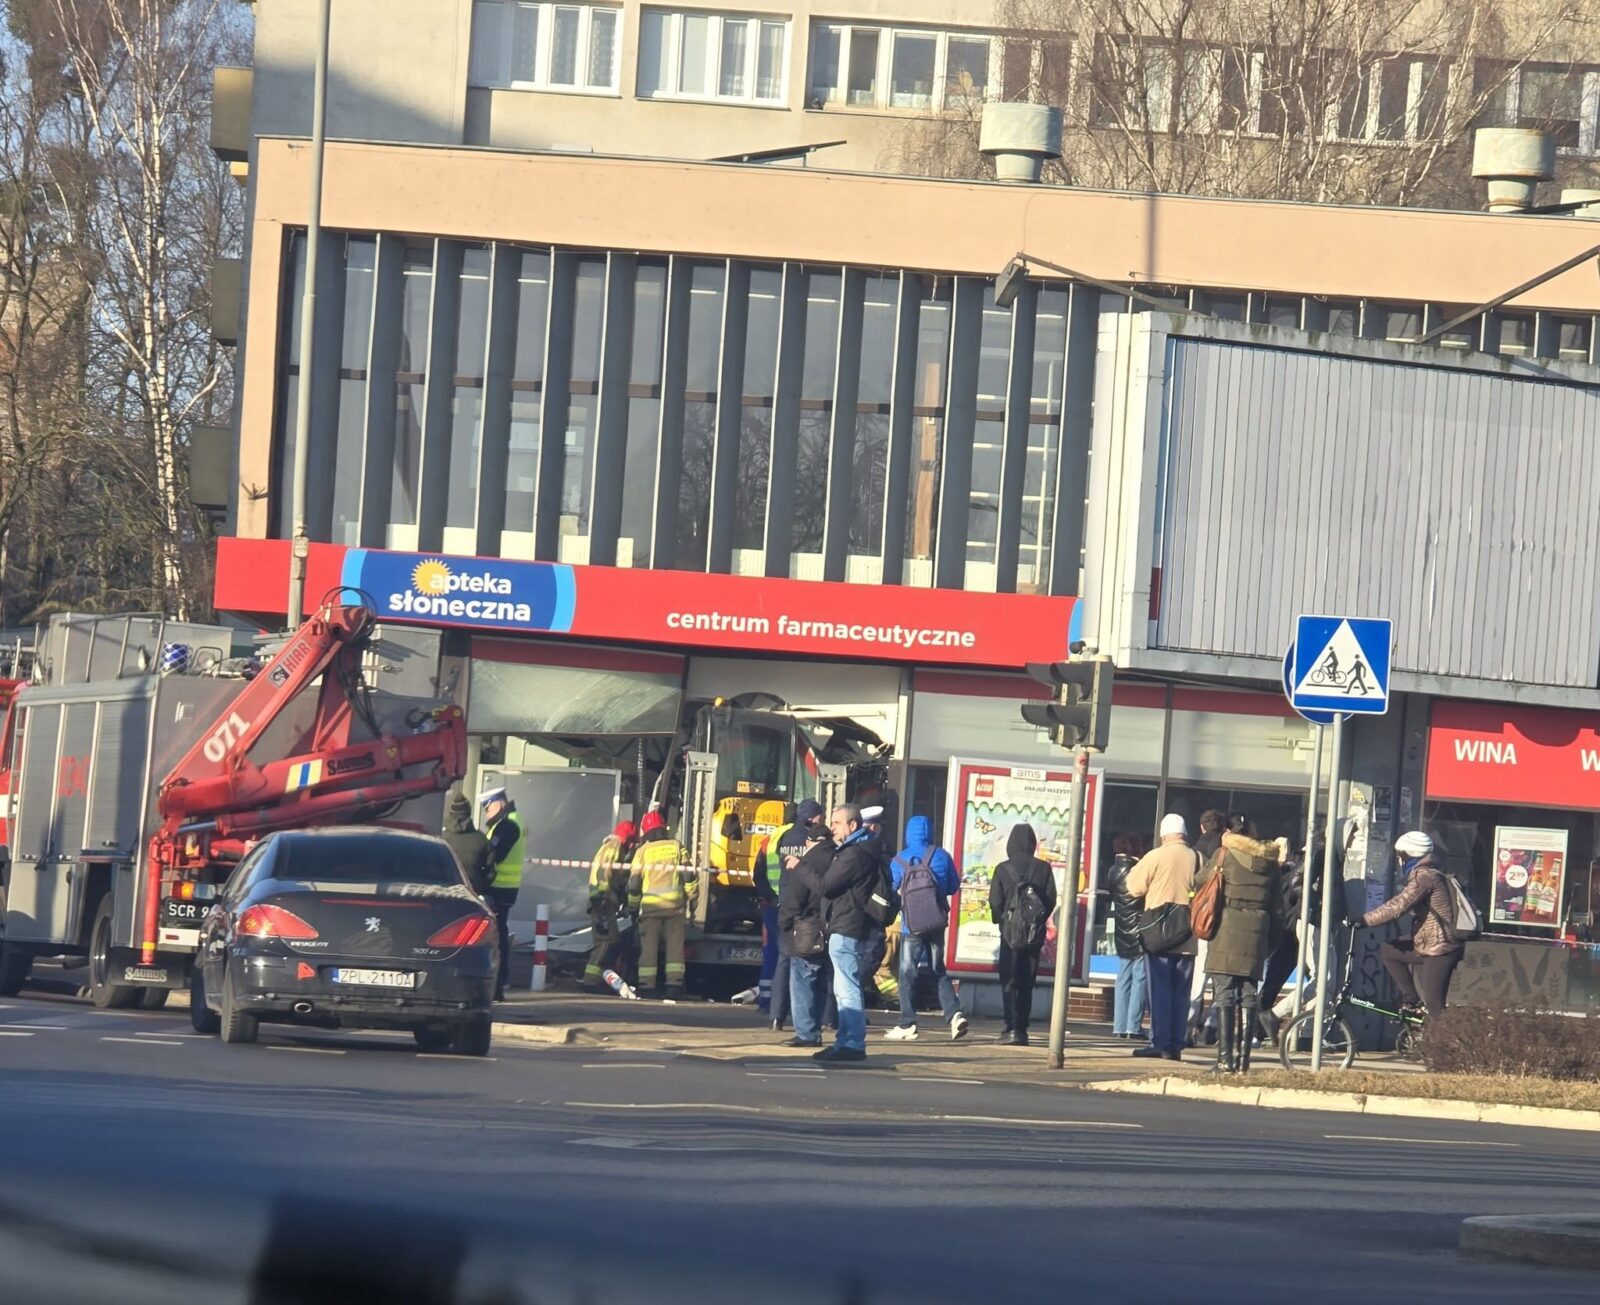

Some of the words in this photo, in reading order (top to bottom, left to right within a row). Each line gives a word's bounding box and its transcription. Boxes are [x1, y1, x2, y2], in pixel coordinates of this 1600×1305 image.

[430, 572, 512, 595] apteka
[389, 590, 531, 622] słoneczna
[666, 611, 769, 634] centrum
[777, 615, 976, 648] farmaceutyczne
[203, 711, 251, 762] 071
[1454, 738, 1518, 766] WINA
[1580, 748, 1600, 772] W
[1016, 768, 1041, 779] ams
[168, 902, 197, 918] SCR
[124, 966, 168, 983] SAURUS
[340, 969, 367, 984] ZPL
[370, 971, 412, 987] 2110A
